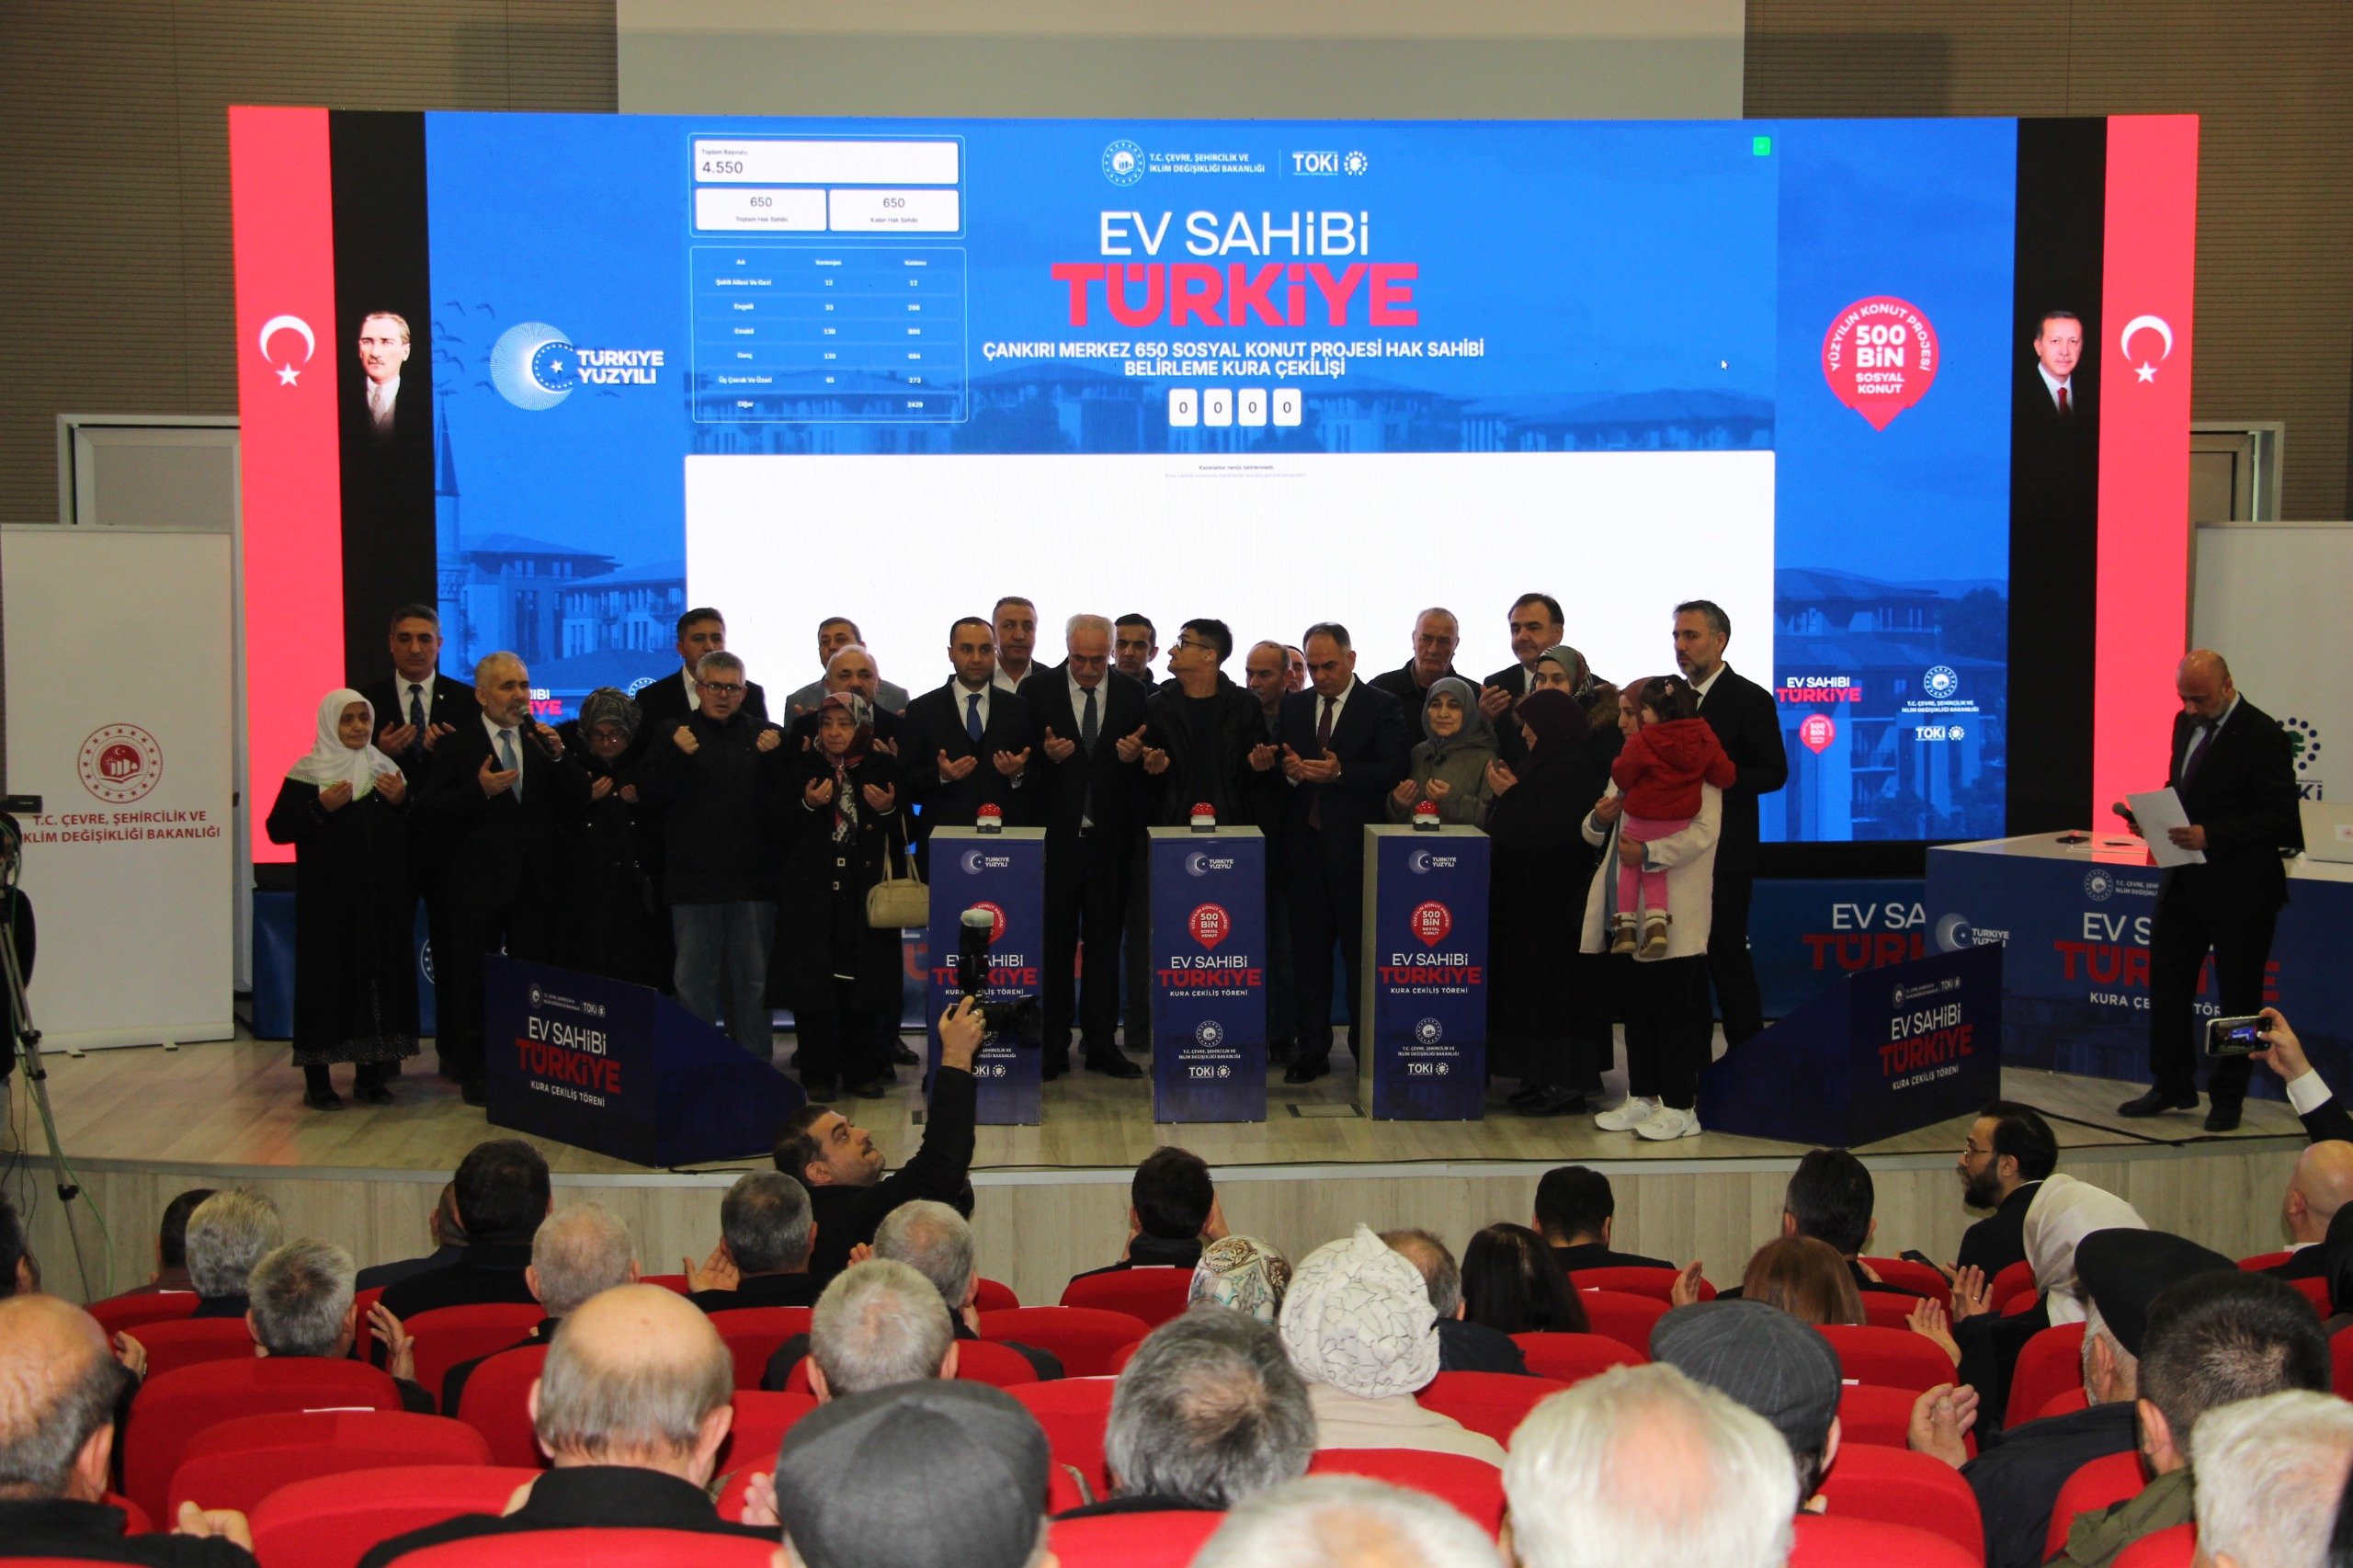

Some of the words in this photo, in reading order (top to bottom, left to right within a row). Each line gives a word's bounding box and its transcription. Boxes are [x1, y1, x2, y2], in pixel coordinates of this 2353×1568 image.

[1150, 153, 1164, 162] T.C.
[1239, 153, 1248, 162] VE
[702, 161, 744, 174] 4.550
[1222, 164, 1265, 173] BAKANLIĞI
[750, 197, 772, 208] 650
[883, 198, 905, 209] 650
[1100, 211, 1173, 256] EV
[1860, 303, 1908, 318] KONUT
[1855, 324, 1906, 346] 500
[983, 342, 1055, 361] ÇANKIRI
[1059, 343, 1131, 358] MERKEZ
[1135, 343, 1168, 358] 650
[1172, 342, 1241, 358] SOSYAL
[1245, 343, 1307, 358] KONUT
[1311, 338, 1382, 358] PROJESİ
[1386, 343, 1423, 358] HAK
[1427, 338, 1484, 358] SAHİBİ
[1124, 358, 1218, 376] BELİRLEME
[1222, 360, 1271, 376] KURA
[1275, 358, 1345, 380] ÇEKİLİŞİ
[1855, 372, 1904, 382] SOSYAL
[1858, 384, 1903, 393] KONUT
[1787, 676, 1804, 687] EV
[33, 815, 58, 826] T.C.
[62, 813, 109, 828] ÇEVRE,
[113, 810, 187, 825] ŞEHİRCİLİK
[189, 811, 207, 822] VE
[23, 830, 58, 843] KLİM
[62, 827, 143, 844] DEĞİŞİKLİĞİ
[147, 825, 221, 840] BAKANLIĞI
[1200, 913, 1219, 921] 500
[1833, 903, 1877, 929] EV
[2083, 912, 2127, 942] EV
[1171, 956, 1192, 969] EV
[1392, 953, 1413, 966] EV
[1192, 990, 1220, 999] ÇEKİLİŞ
[1413, 986, 1440, 995] ÇEKİLİŞ
[2090, 993, 2128, 1007] KURA
[529, 1016, 550, 1040] EV
[1892, 1015, 1911, 1040] EV
[1893, 1078, 1910, 1090] KURA
[1937, 1064, 1959, 1078] TÖRENİ
[531, 1080, 550, 1093] KURA
[579, 1091, 605, 1107] TÖRENİ
